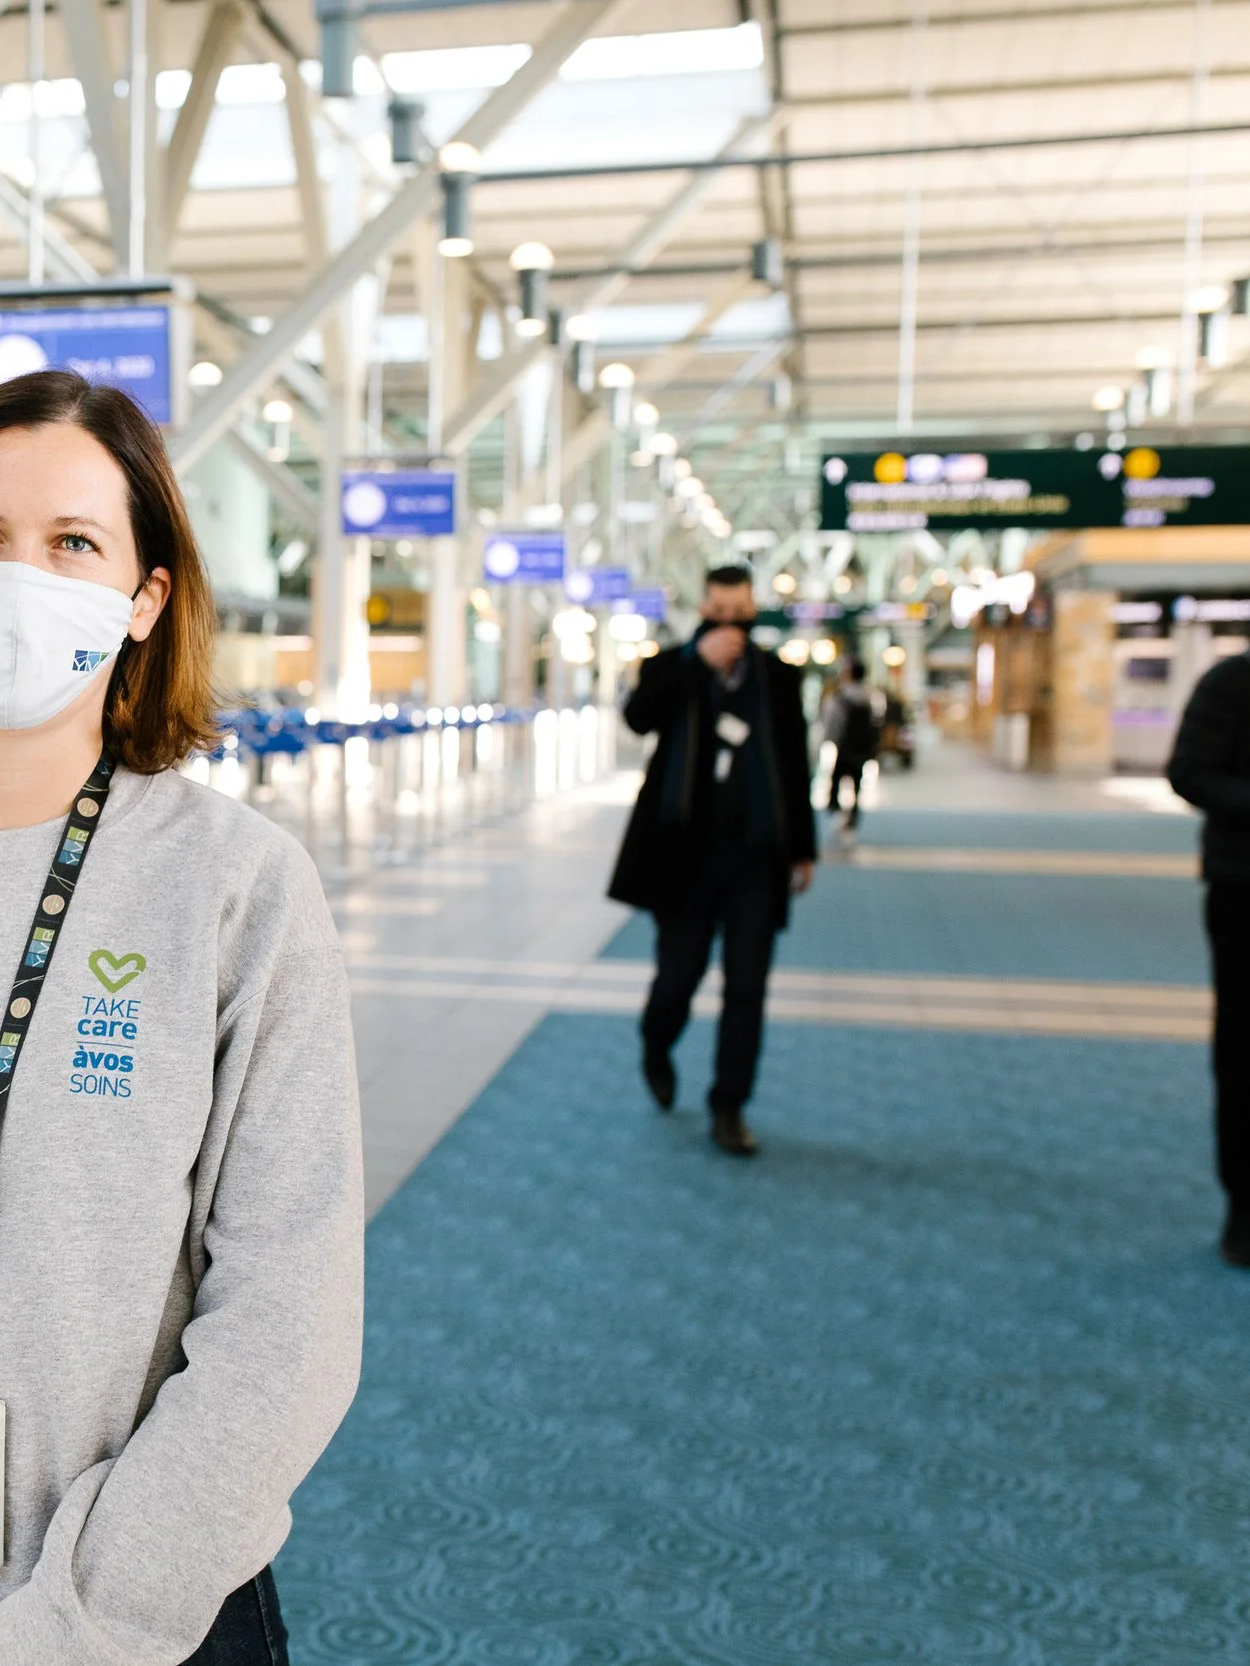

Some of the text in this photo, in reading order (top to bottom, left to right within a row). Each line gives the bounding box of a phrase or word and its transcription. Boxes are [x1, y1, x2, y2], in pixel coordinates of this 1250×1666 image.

[65, 830, 90, 866] YVR
[31, 929, 55, 967] YVR
[81, 995, 141, 1019] TAKE
[77, 1018, 137, 1040] care
[0, 1033, 20, 1073] YVR
[72, 1045, 134, 1073] àvos
[69, 1073, 132, 1098] SOINS
